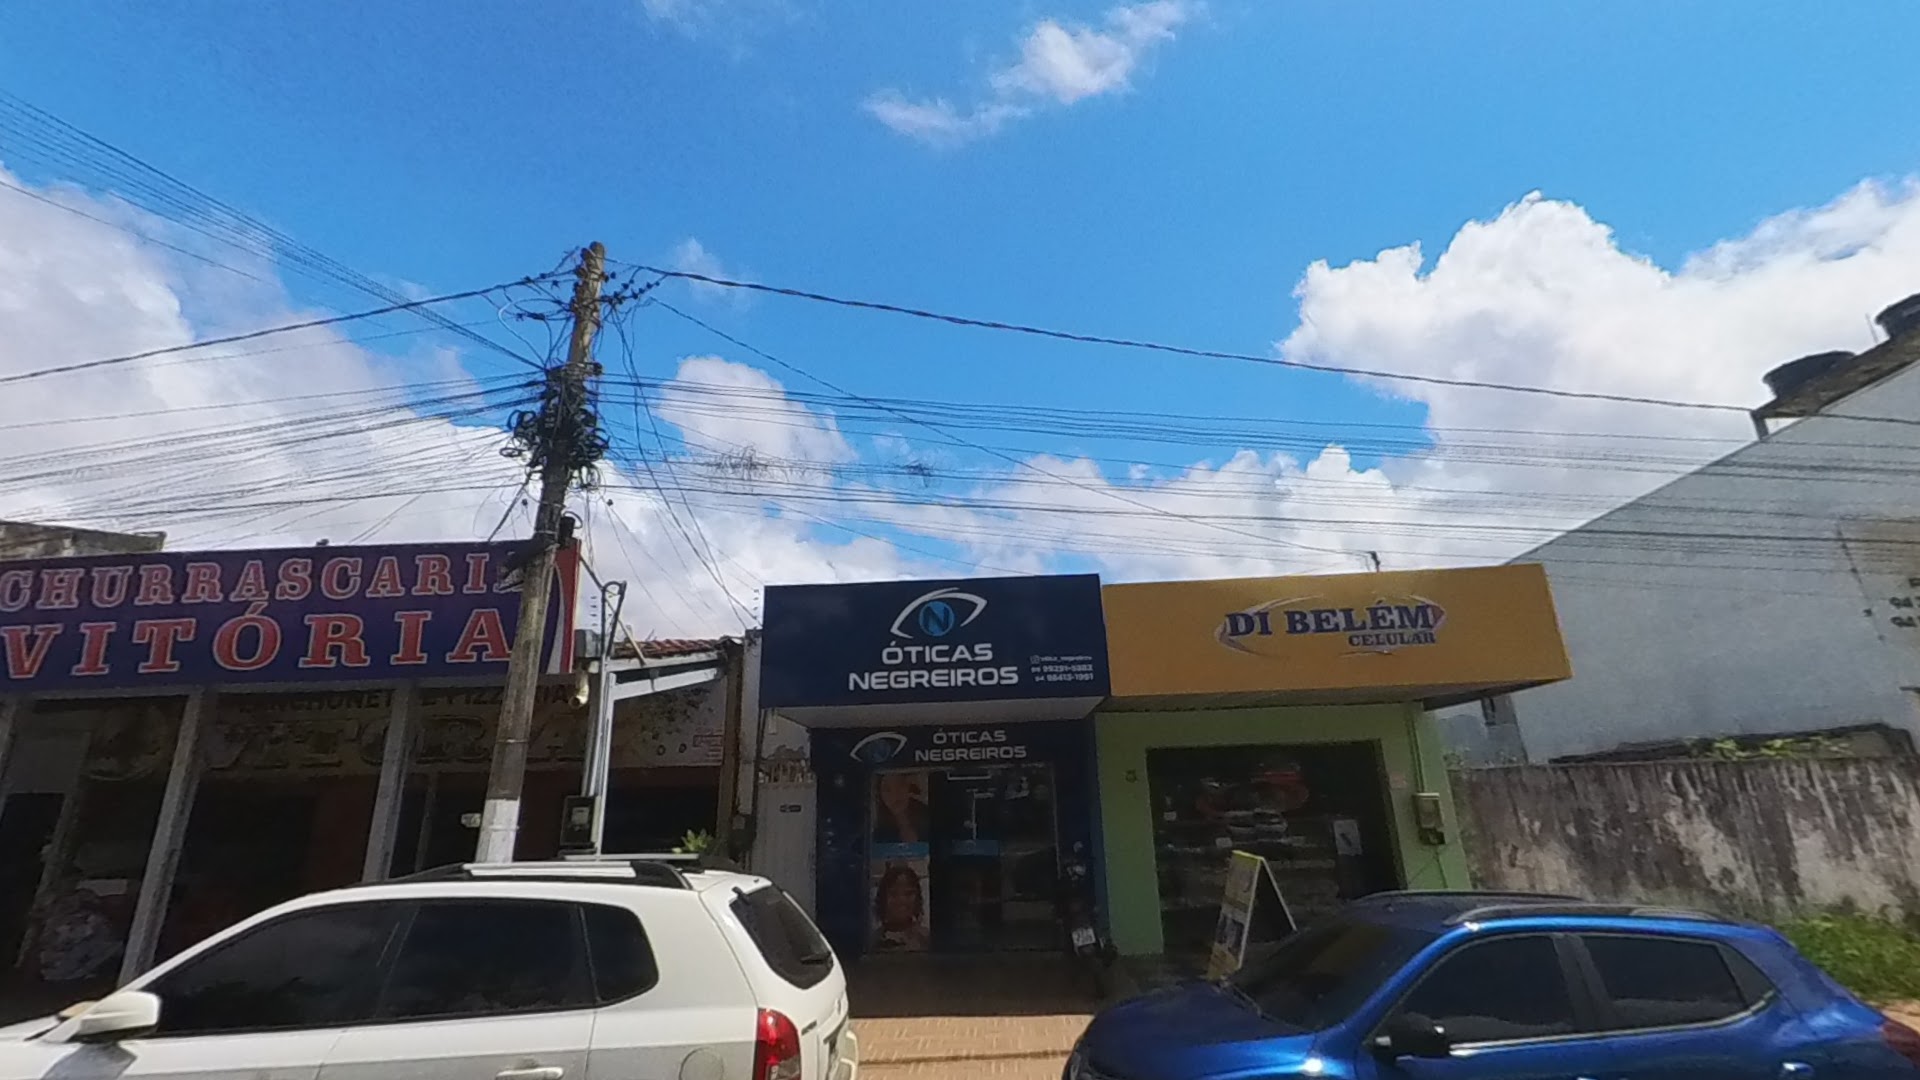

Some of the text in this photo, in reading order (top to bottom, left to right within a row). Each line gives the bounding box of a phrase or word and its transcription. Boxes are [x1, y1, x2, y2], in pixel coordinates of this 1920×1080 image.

[1225, 600, 1434, 637] DI BELÉM
[1, 602, 512, 678] VITÓRIA
[1348, 631, 1436, 647] CELULAR
[881, 640, 993, 665] ÓTICAS
[848, 666, 1019, 691] NEGREIROS
[932, 729, 1007, 745] ÓTICAS
[915, 746, 1027, 762] NEGREIROS
